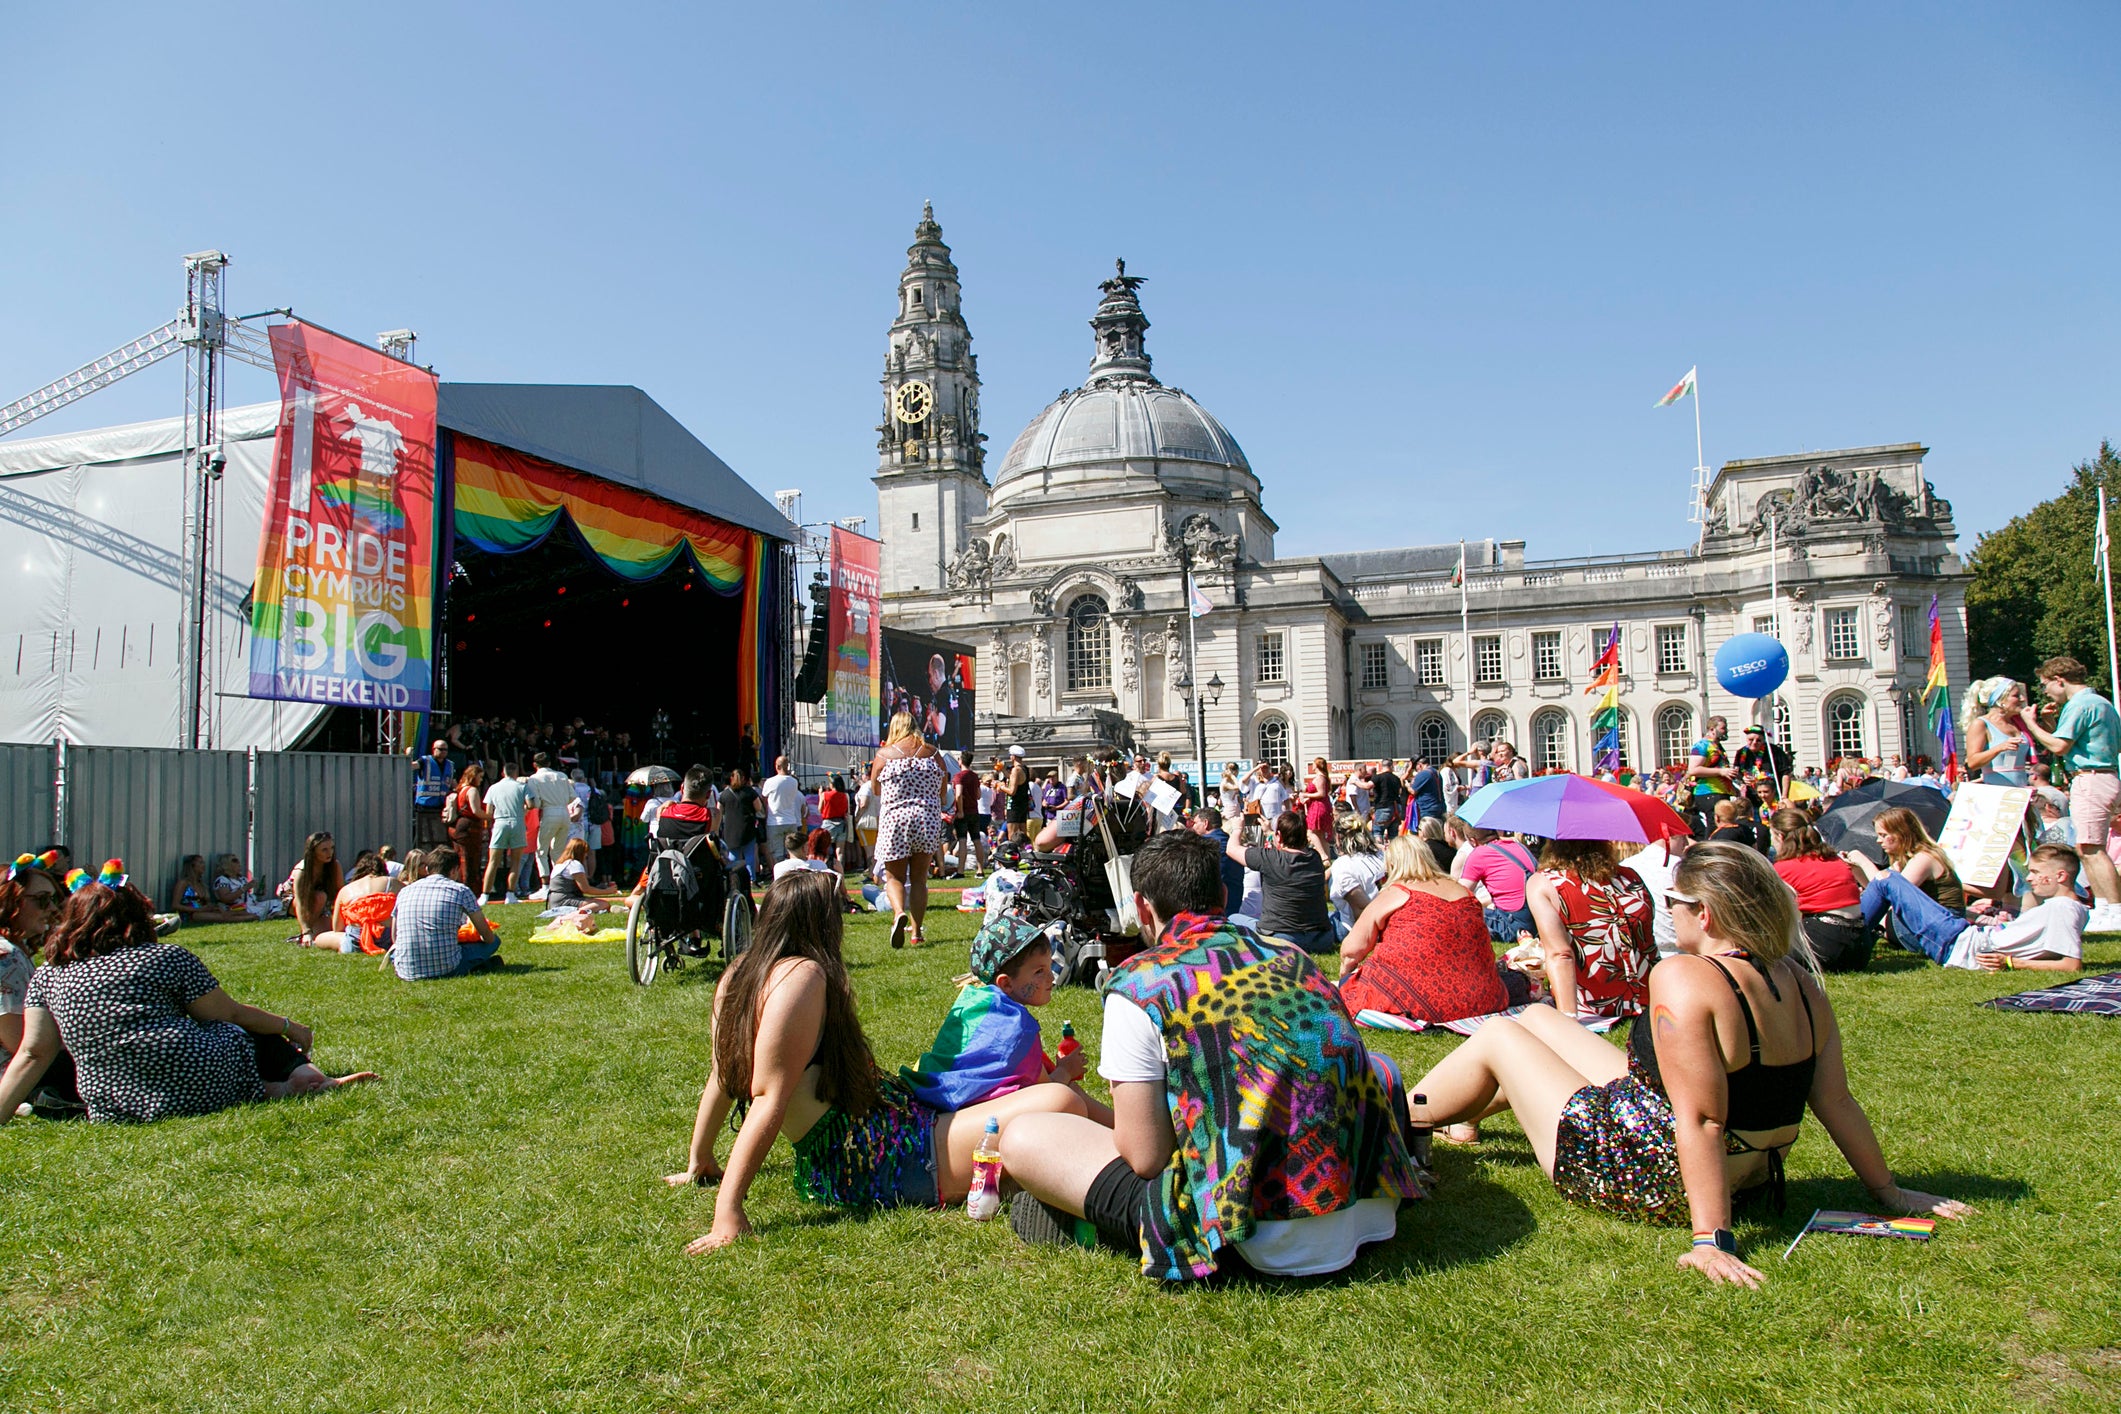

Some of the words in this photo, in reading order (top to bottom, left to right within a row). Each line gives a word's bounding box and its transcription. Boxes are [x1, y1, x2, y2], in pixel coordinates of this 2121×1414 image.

[285, 516, 406, 582] PRIDE
[283, 563, 405, 611] CYMRU'S
[281, 595, 408, 680] BIG
[1729, 659, 1767, 675] TESCO
[279, 671, 410, 708] WEEKEND
[835, 681, 870, 705] MAWR
[835, 703, 870, 728] PRIDE
[836, 724, 871, 745] CYMRU
[1331, 762, 1355, 771] Street
[1061, 812, 1081, 821] LOV
[1970, 789, 2029, 882] BRIDGEND
